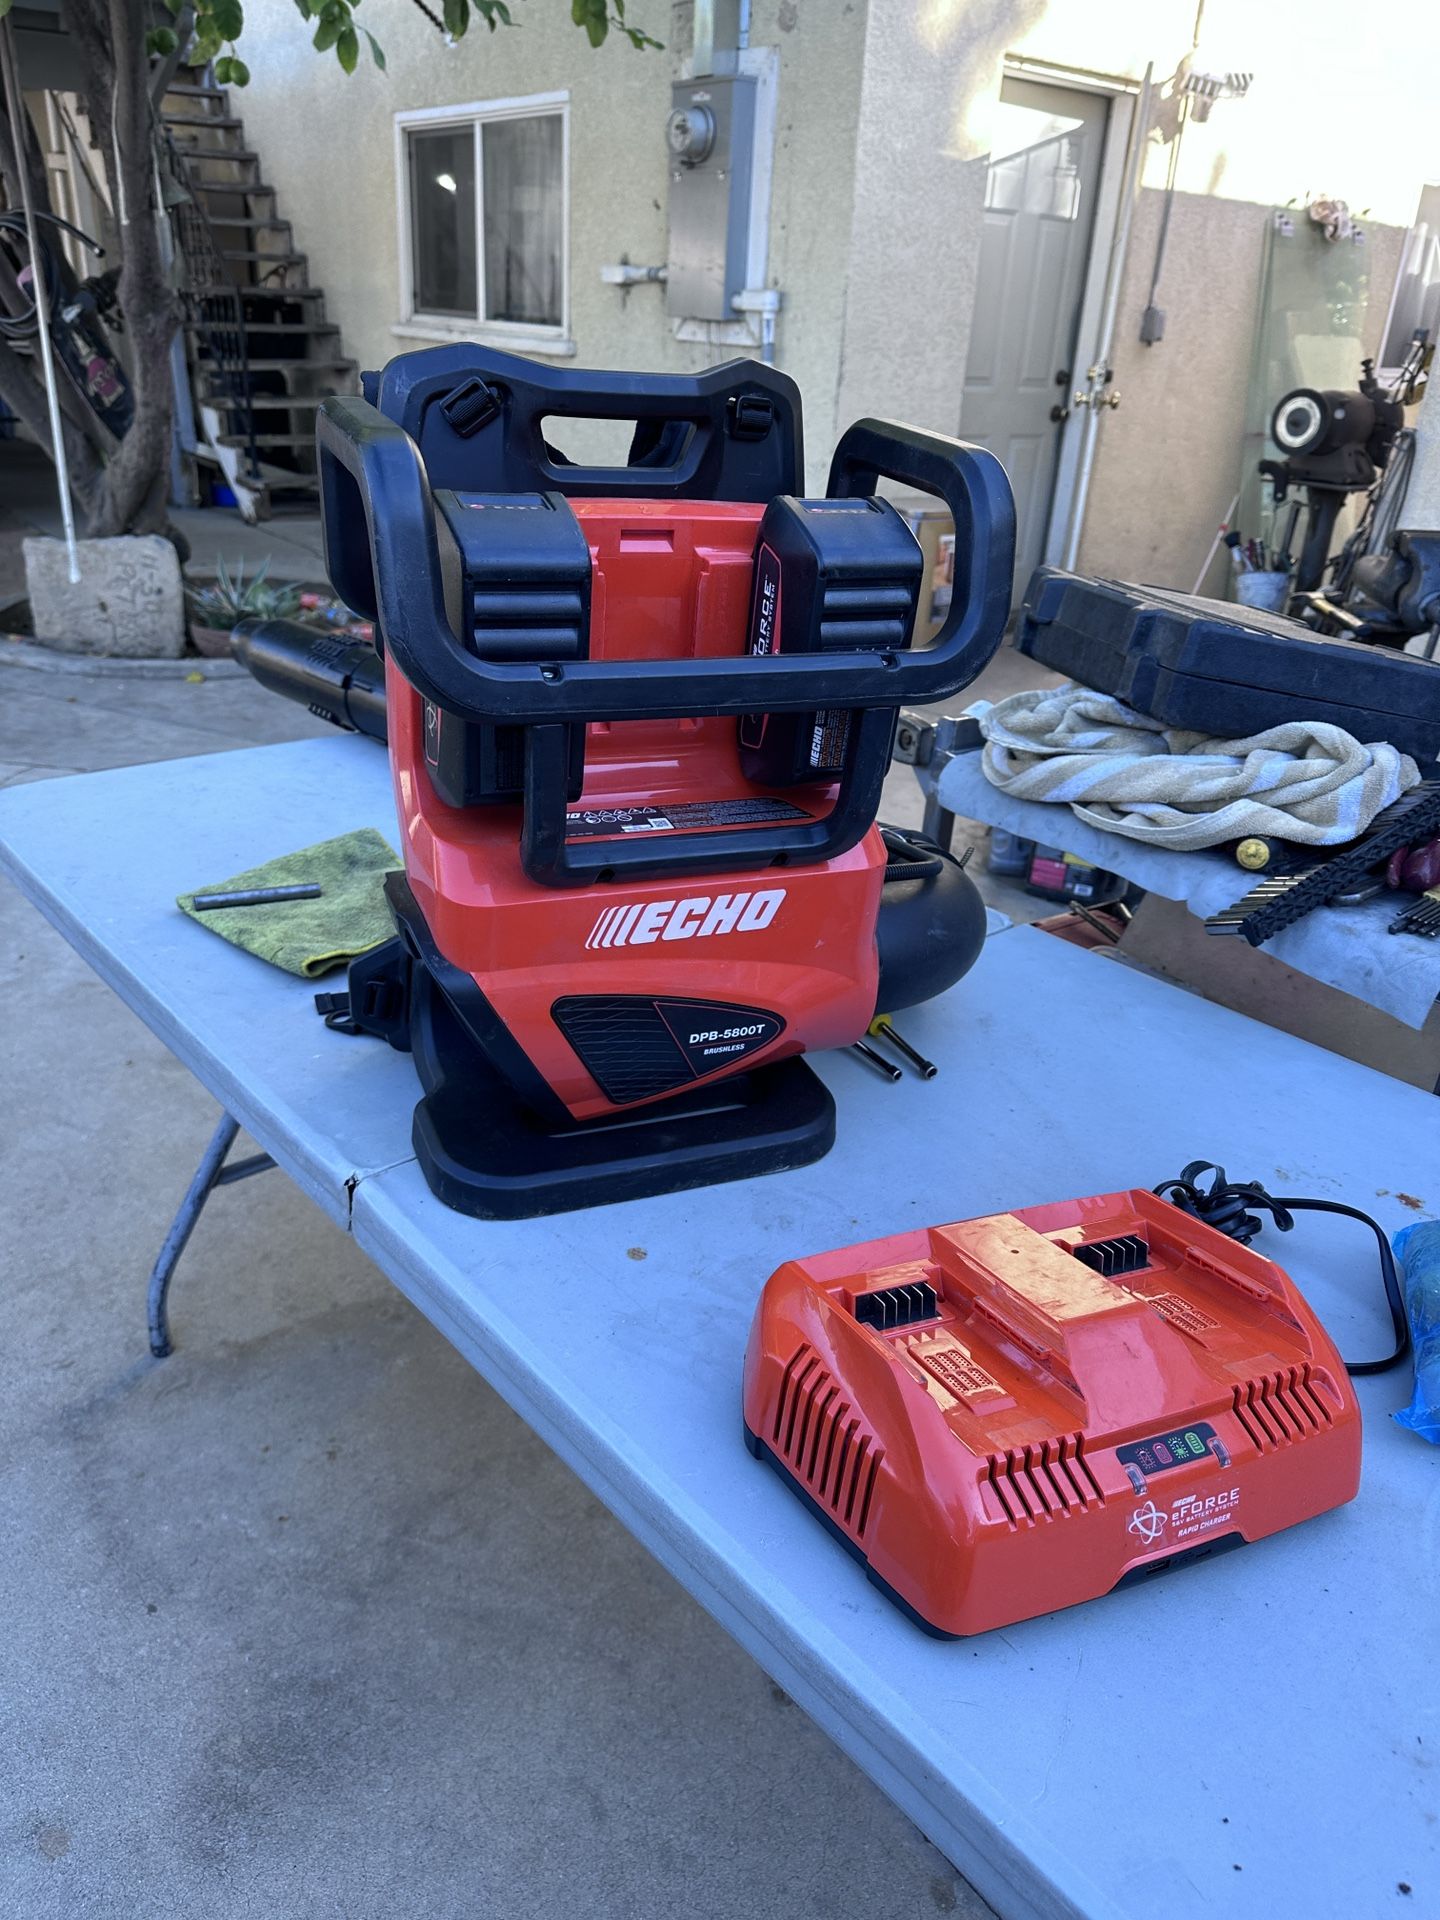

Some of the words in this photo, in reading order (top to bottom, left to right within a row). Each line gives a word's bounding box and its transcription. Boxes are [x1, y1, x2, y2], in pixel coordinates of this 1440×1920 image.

[809, 725, 823, 763] ECHO
[602, 888, 787, 947] ECHO
[689, 1023, 766, 1044] DPB-5800T
[703, 1043, 746, 1056] BRUSHLESS
[1172, 1488, 1240, 1520] eFORCE
[1186, 1509, 1213, 1522] BATTERY
[1215, 1500, 1239, 1512] SYSTEM
[1178, 1524, 1199, 1537] RAPID
[1200, 1513, 1231, 1529] CHARGER
